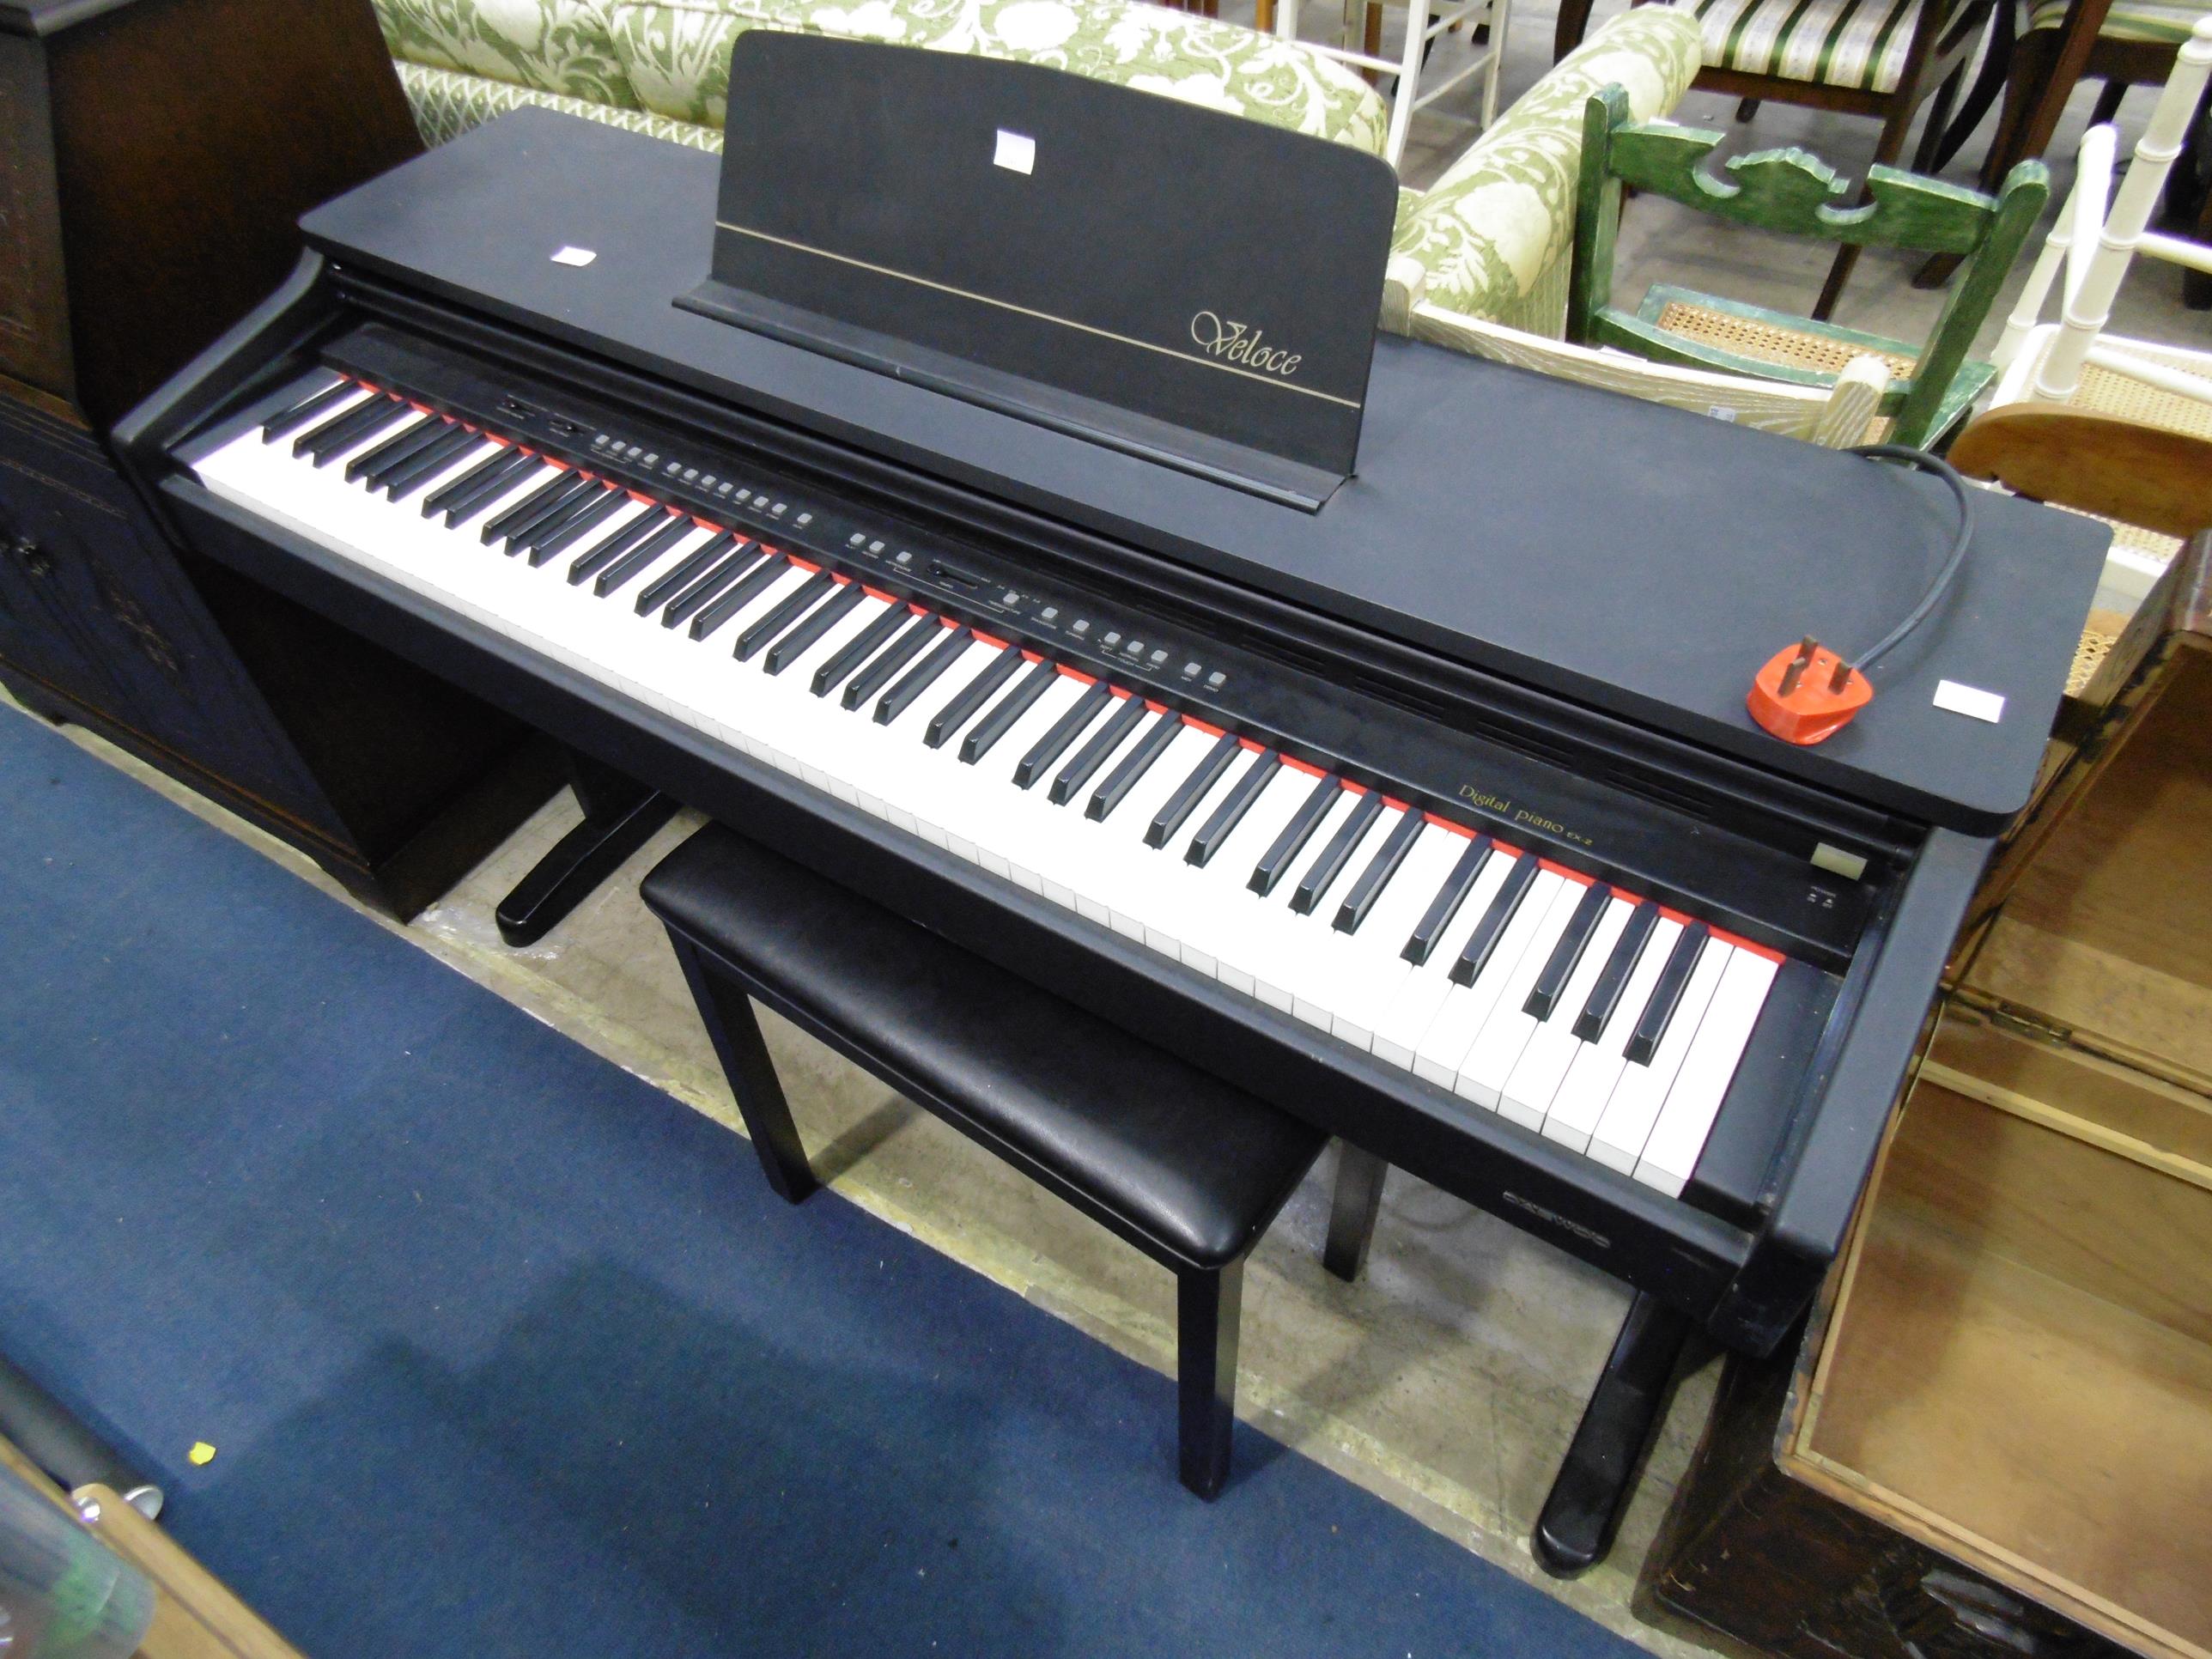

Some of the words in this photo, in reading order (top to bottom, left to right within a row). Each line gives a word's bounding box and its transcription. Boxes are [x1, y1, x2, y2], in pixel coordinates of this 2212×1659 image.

[1191, 311, 1303, 375] Veloce
[1458, 784, 1511, 812] Digital
[1514, 809, 1565, 834] piano
